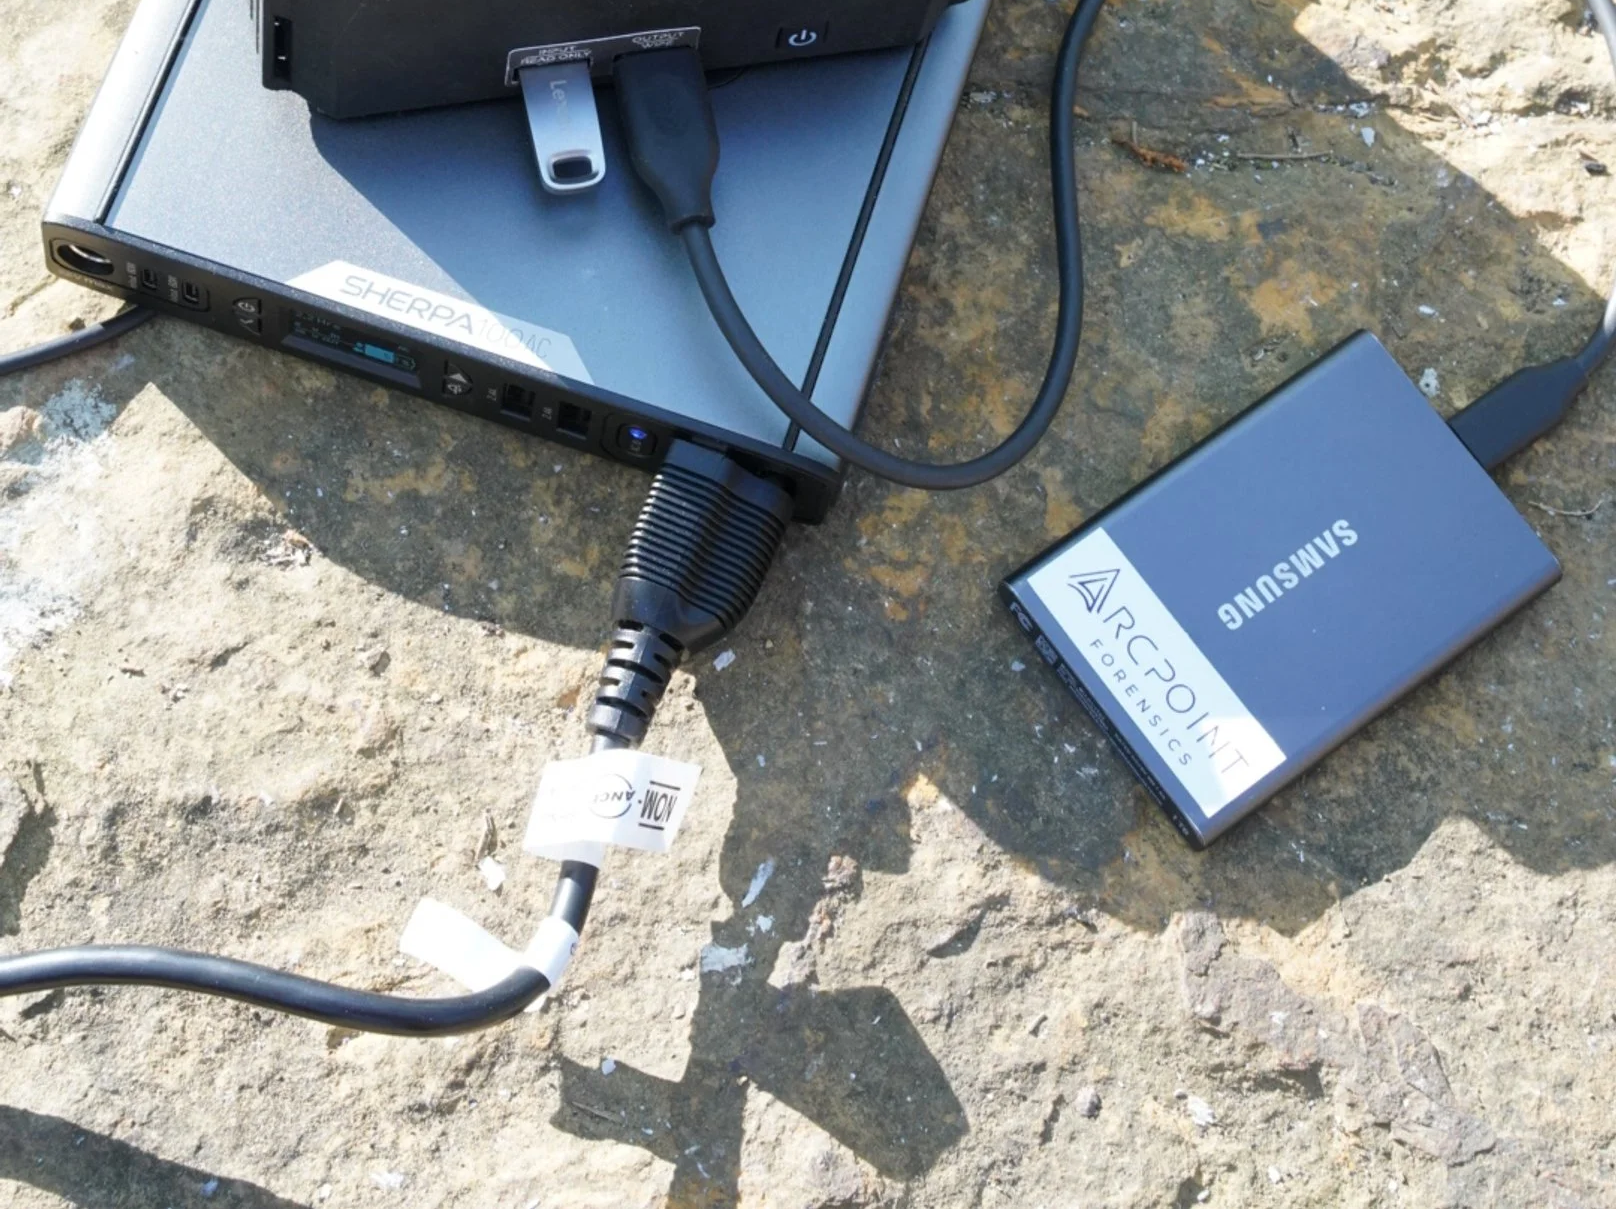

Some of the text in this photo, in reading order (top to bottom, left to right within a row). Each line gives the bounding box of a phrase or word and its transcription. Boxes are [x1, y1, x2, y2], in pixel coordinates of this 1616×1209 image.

[519, 48, 592, 66] READ ONLY
[538, 45, 577, 56] INPUT
[631, 31, 686, 43] OUTPUT
[338, 274, 474, 336] SHERPA
[1216, 518, 1359, 631] SAMSUNG
[1088, 638, 1193, 767] FORENSICS
